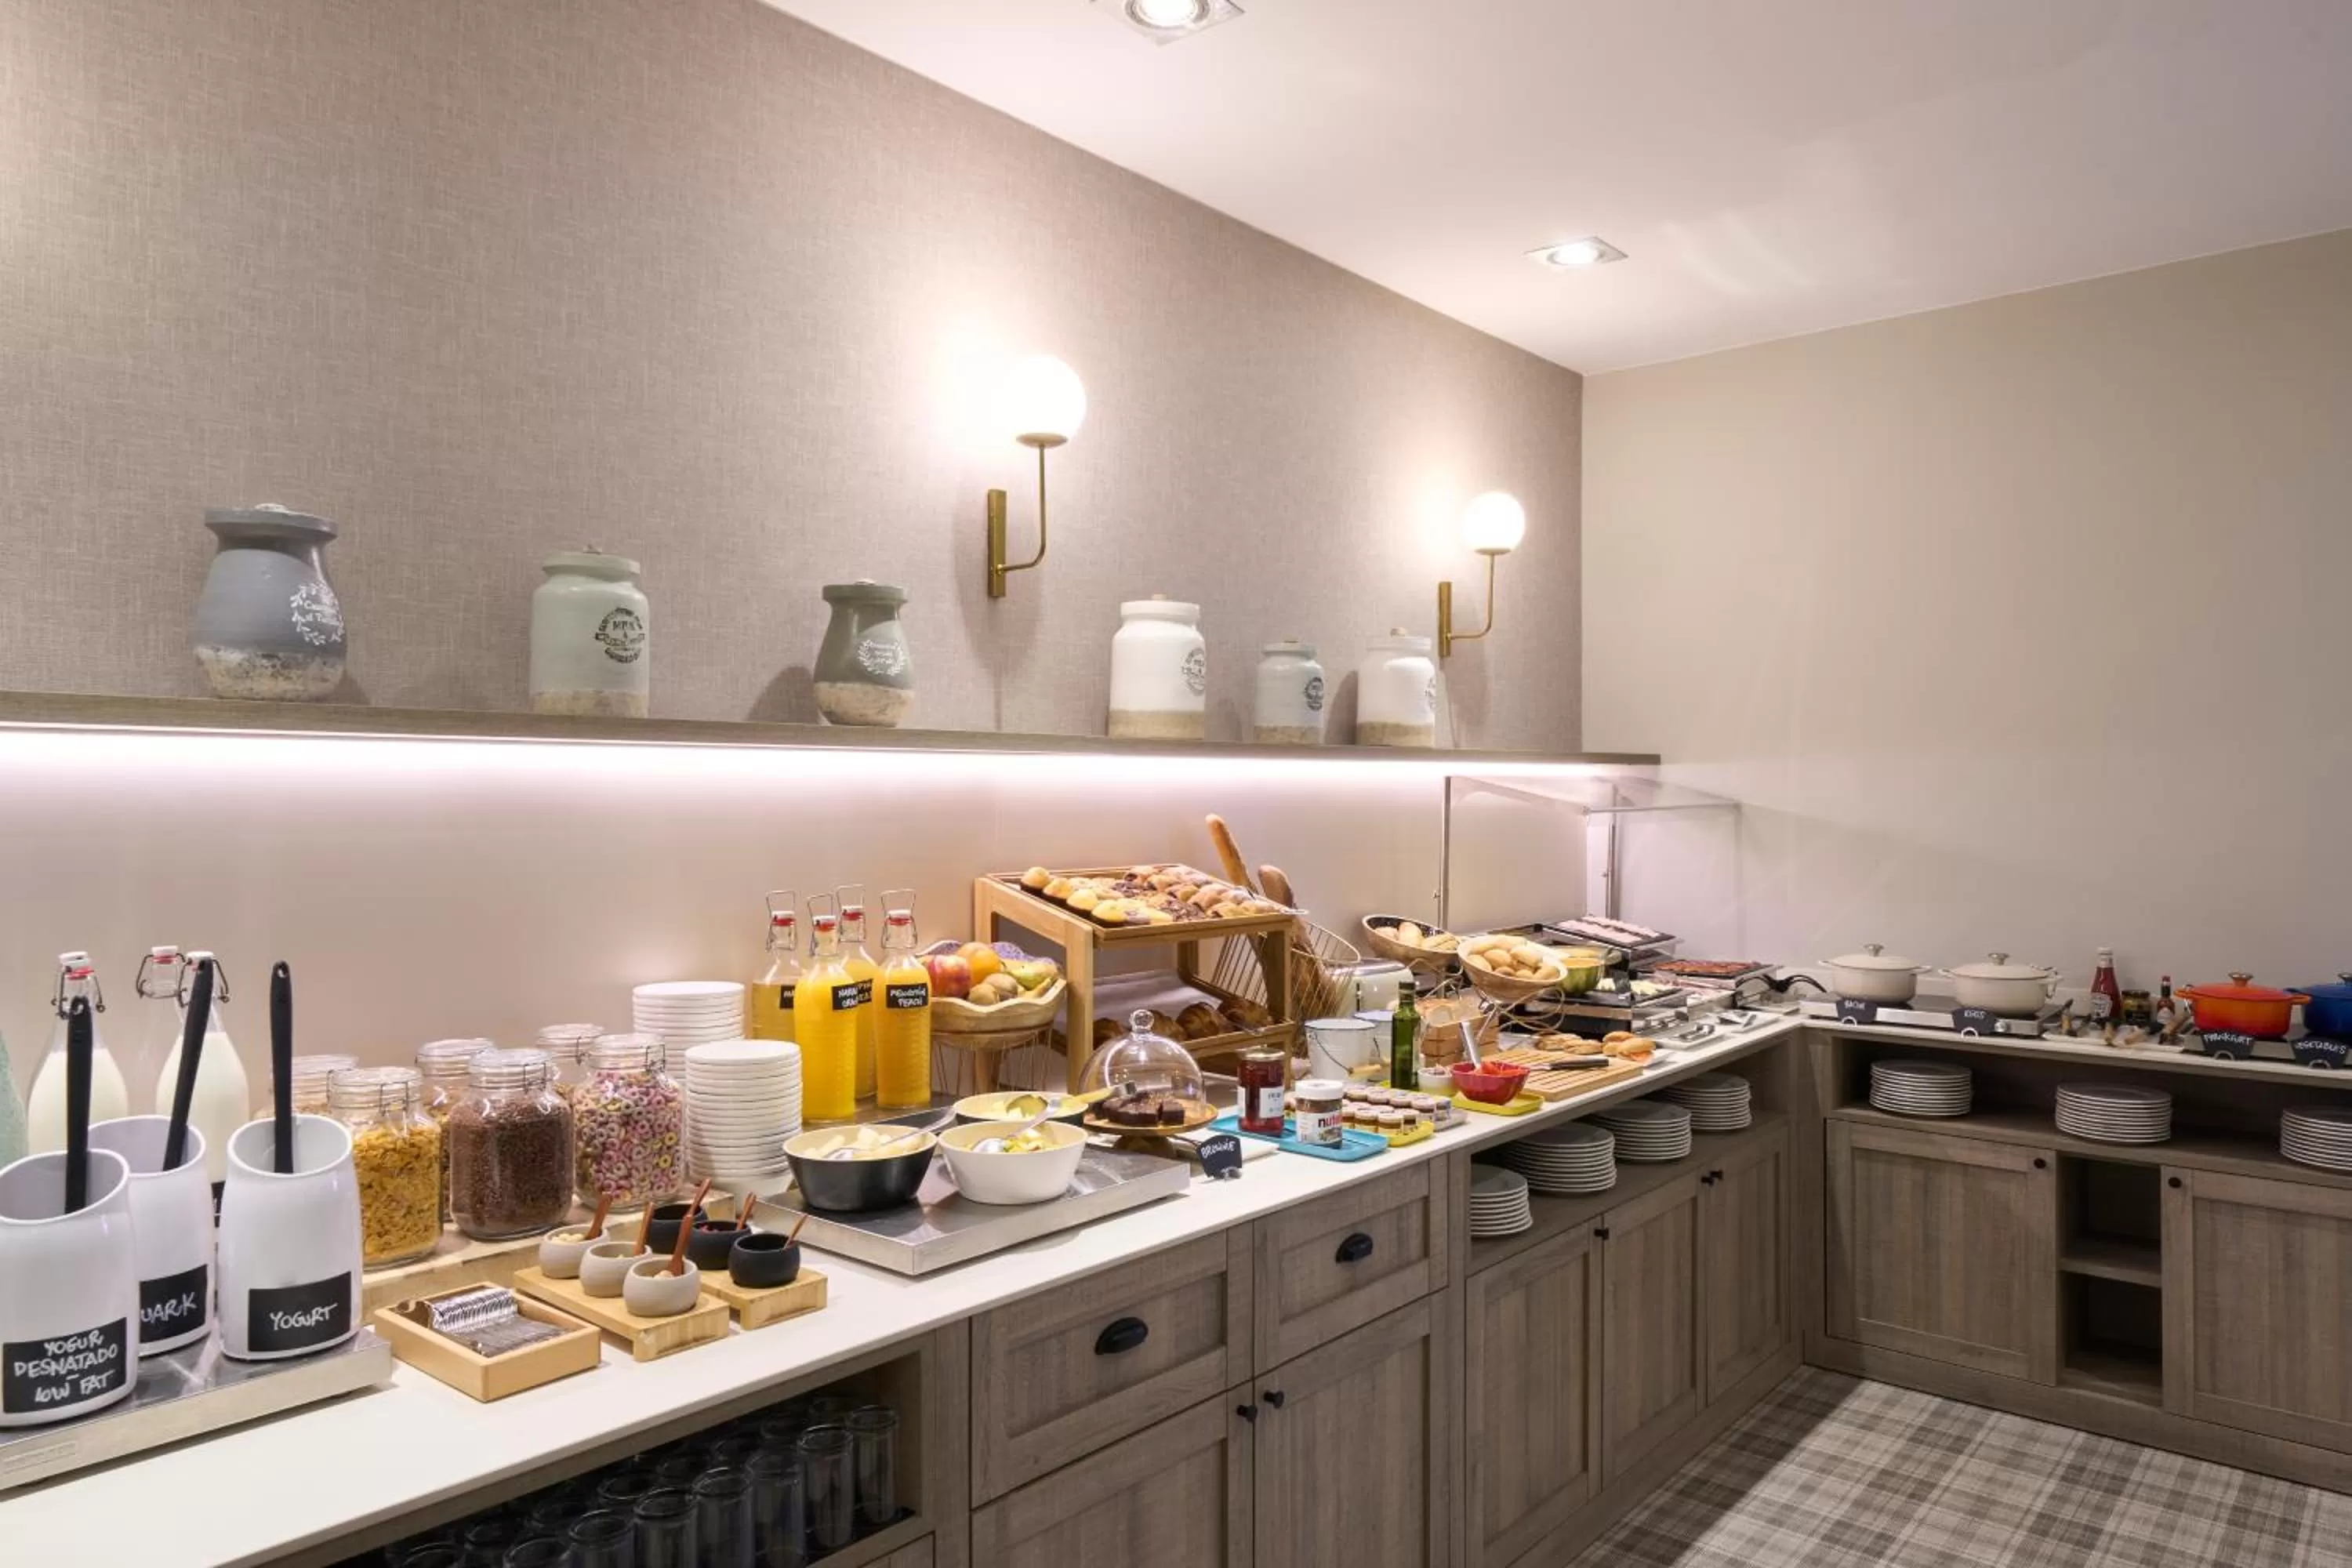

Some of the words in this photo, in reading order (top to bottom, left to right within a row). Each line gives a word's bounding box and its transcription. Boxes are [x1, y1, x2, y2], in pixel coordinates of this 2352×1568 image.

[140, 1291, 198, 1323] UARK
[269, 1301, 339, 1330] YOGURT
[43, 1329, 104, 1356] YOGUR
[13, 1343, 118, 1378] DESNATADO
[79, 1369, 116, 1395] FAT
